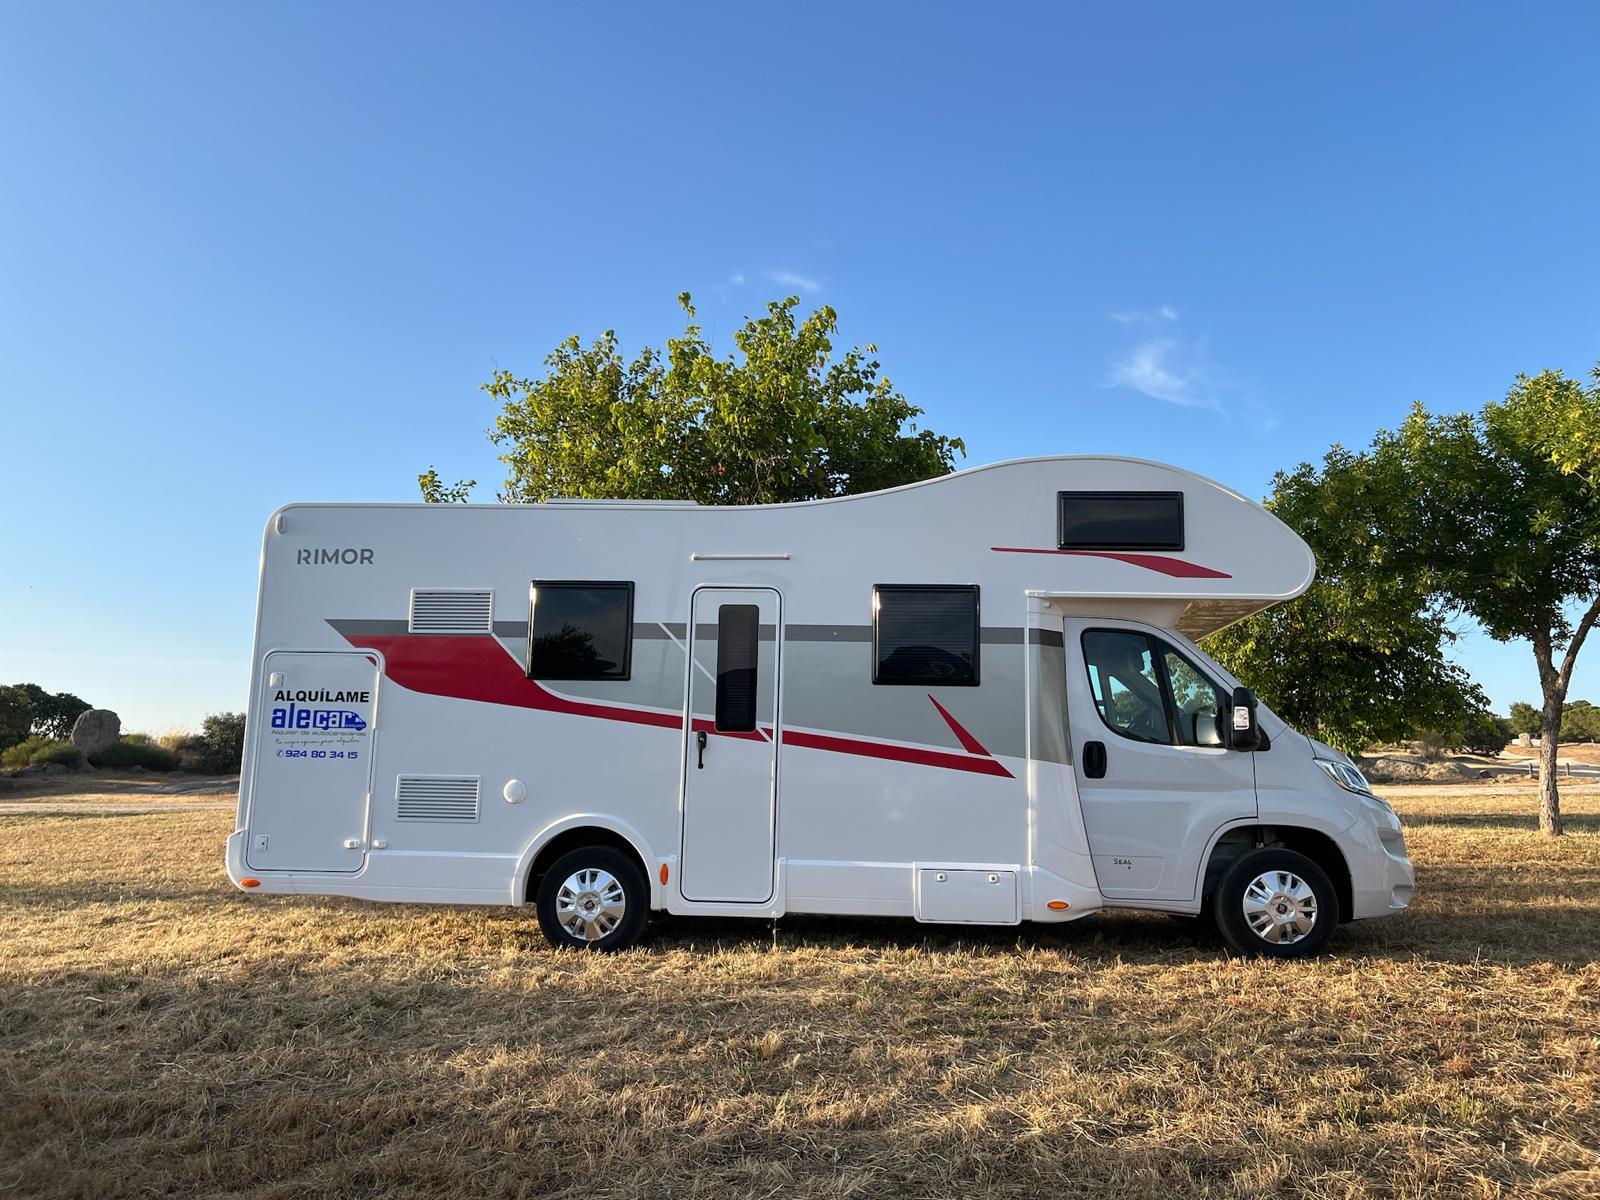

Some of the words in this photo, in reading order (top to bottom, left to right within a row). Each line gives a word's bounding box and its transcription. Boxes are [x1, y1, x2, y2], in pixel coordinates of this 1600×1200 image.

[297, 548, 374, 565] RIMOR
[274, 688, 370, 703] ALQUÍLAME
[271, 703, 353, 729] alecar
[285, 749, 307, 757] 924
[311, 750, 326, 758] 80
[329, 751, 344, 759] 34
[347, 751, 358, 759] 15
